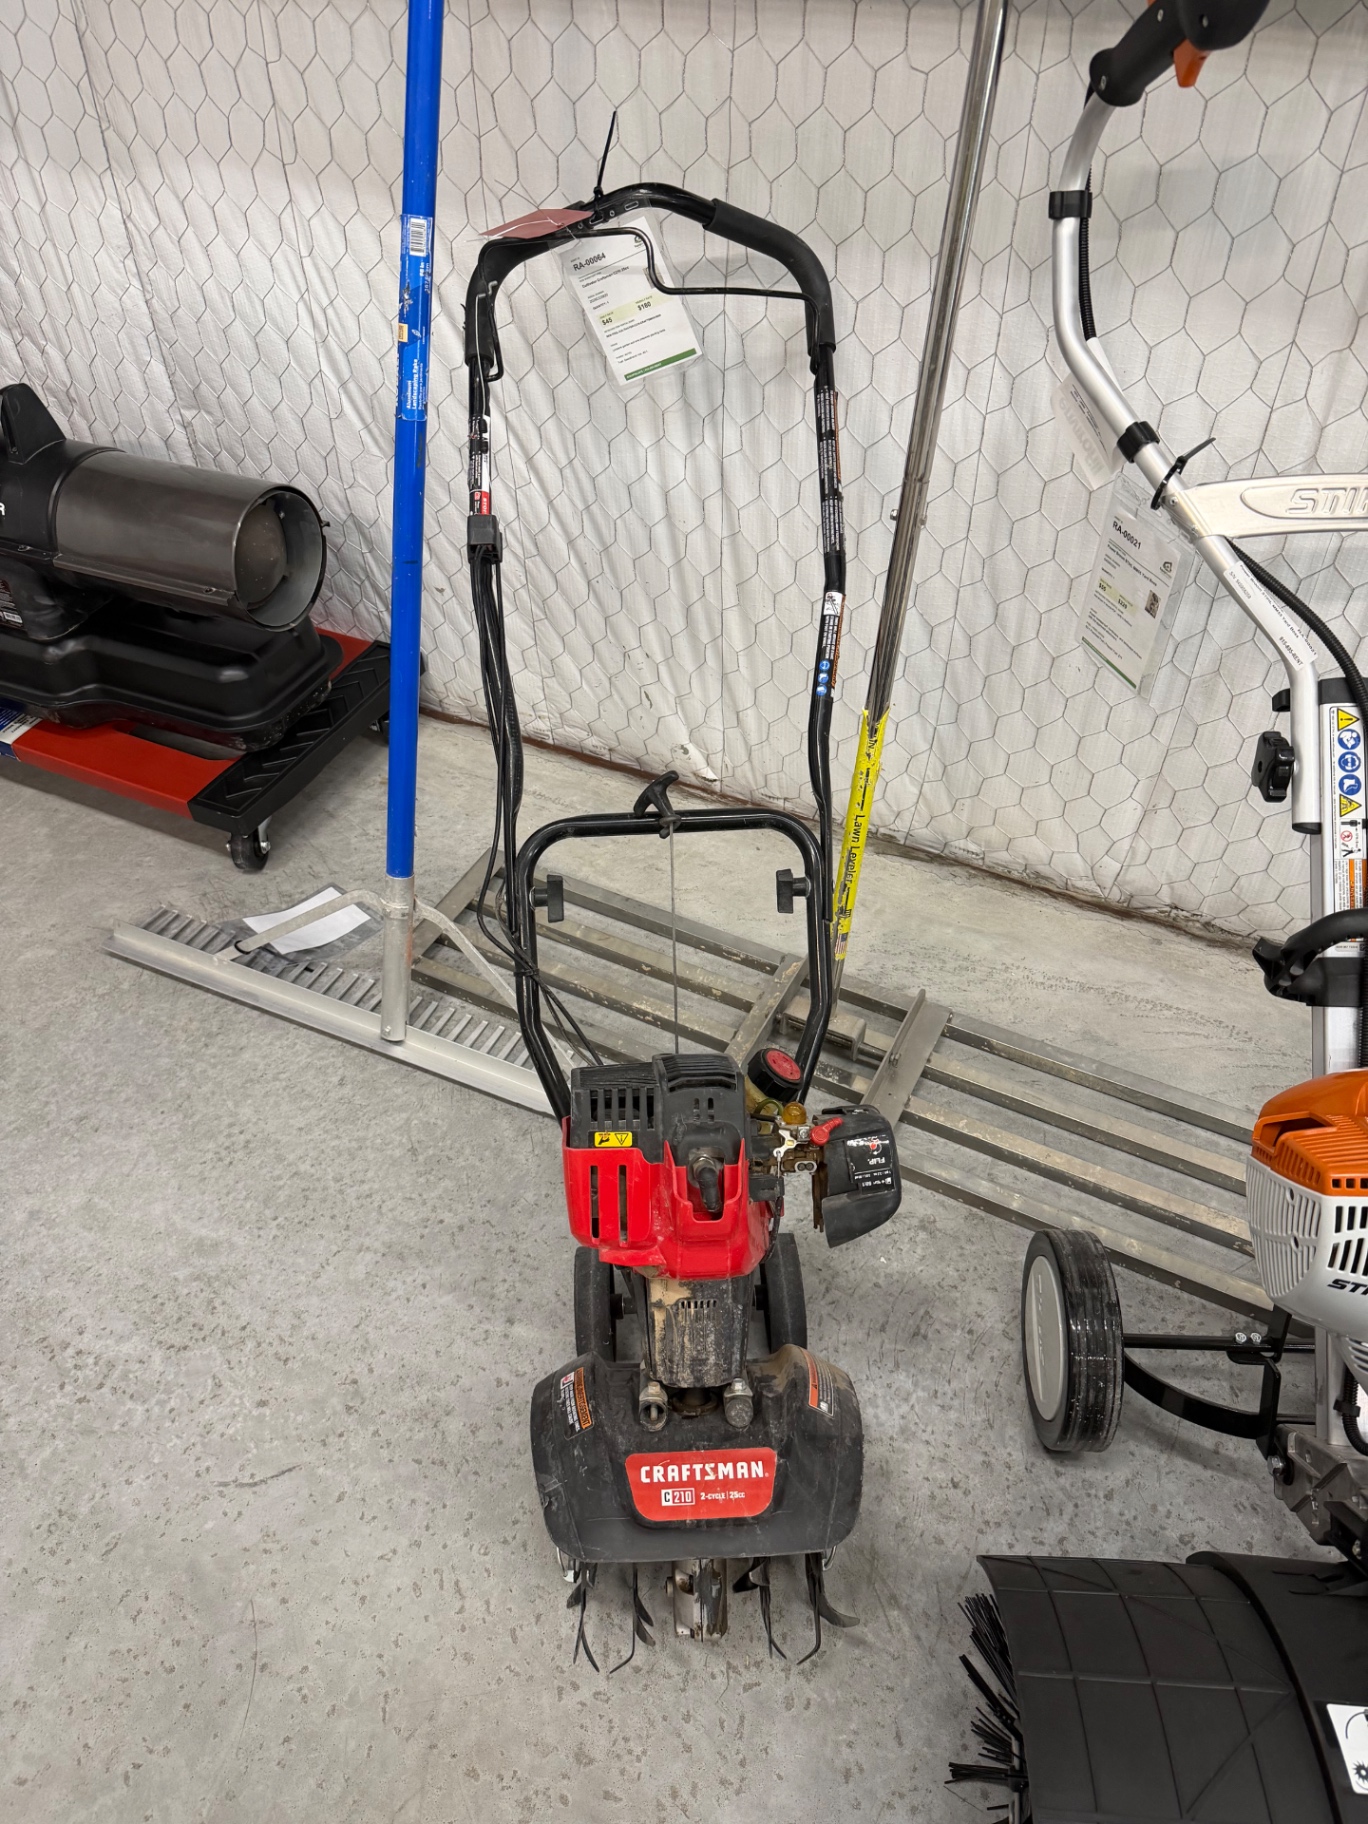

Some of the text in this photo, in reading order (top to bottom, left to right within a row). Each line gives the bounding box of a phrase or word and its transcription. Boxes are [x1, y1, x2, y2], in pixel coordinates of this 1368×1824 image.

[573, 252, 606, 271] RA-00064
[637, 301, 652, 311] $180
[601, 317, 613, 326] $45
[1113, 521, 1141, 550] RA-00021
[852, 814, 865, 843] Lawn
[640, 1460, 764, 1483] CRAFTSMAN
